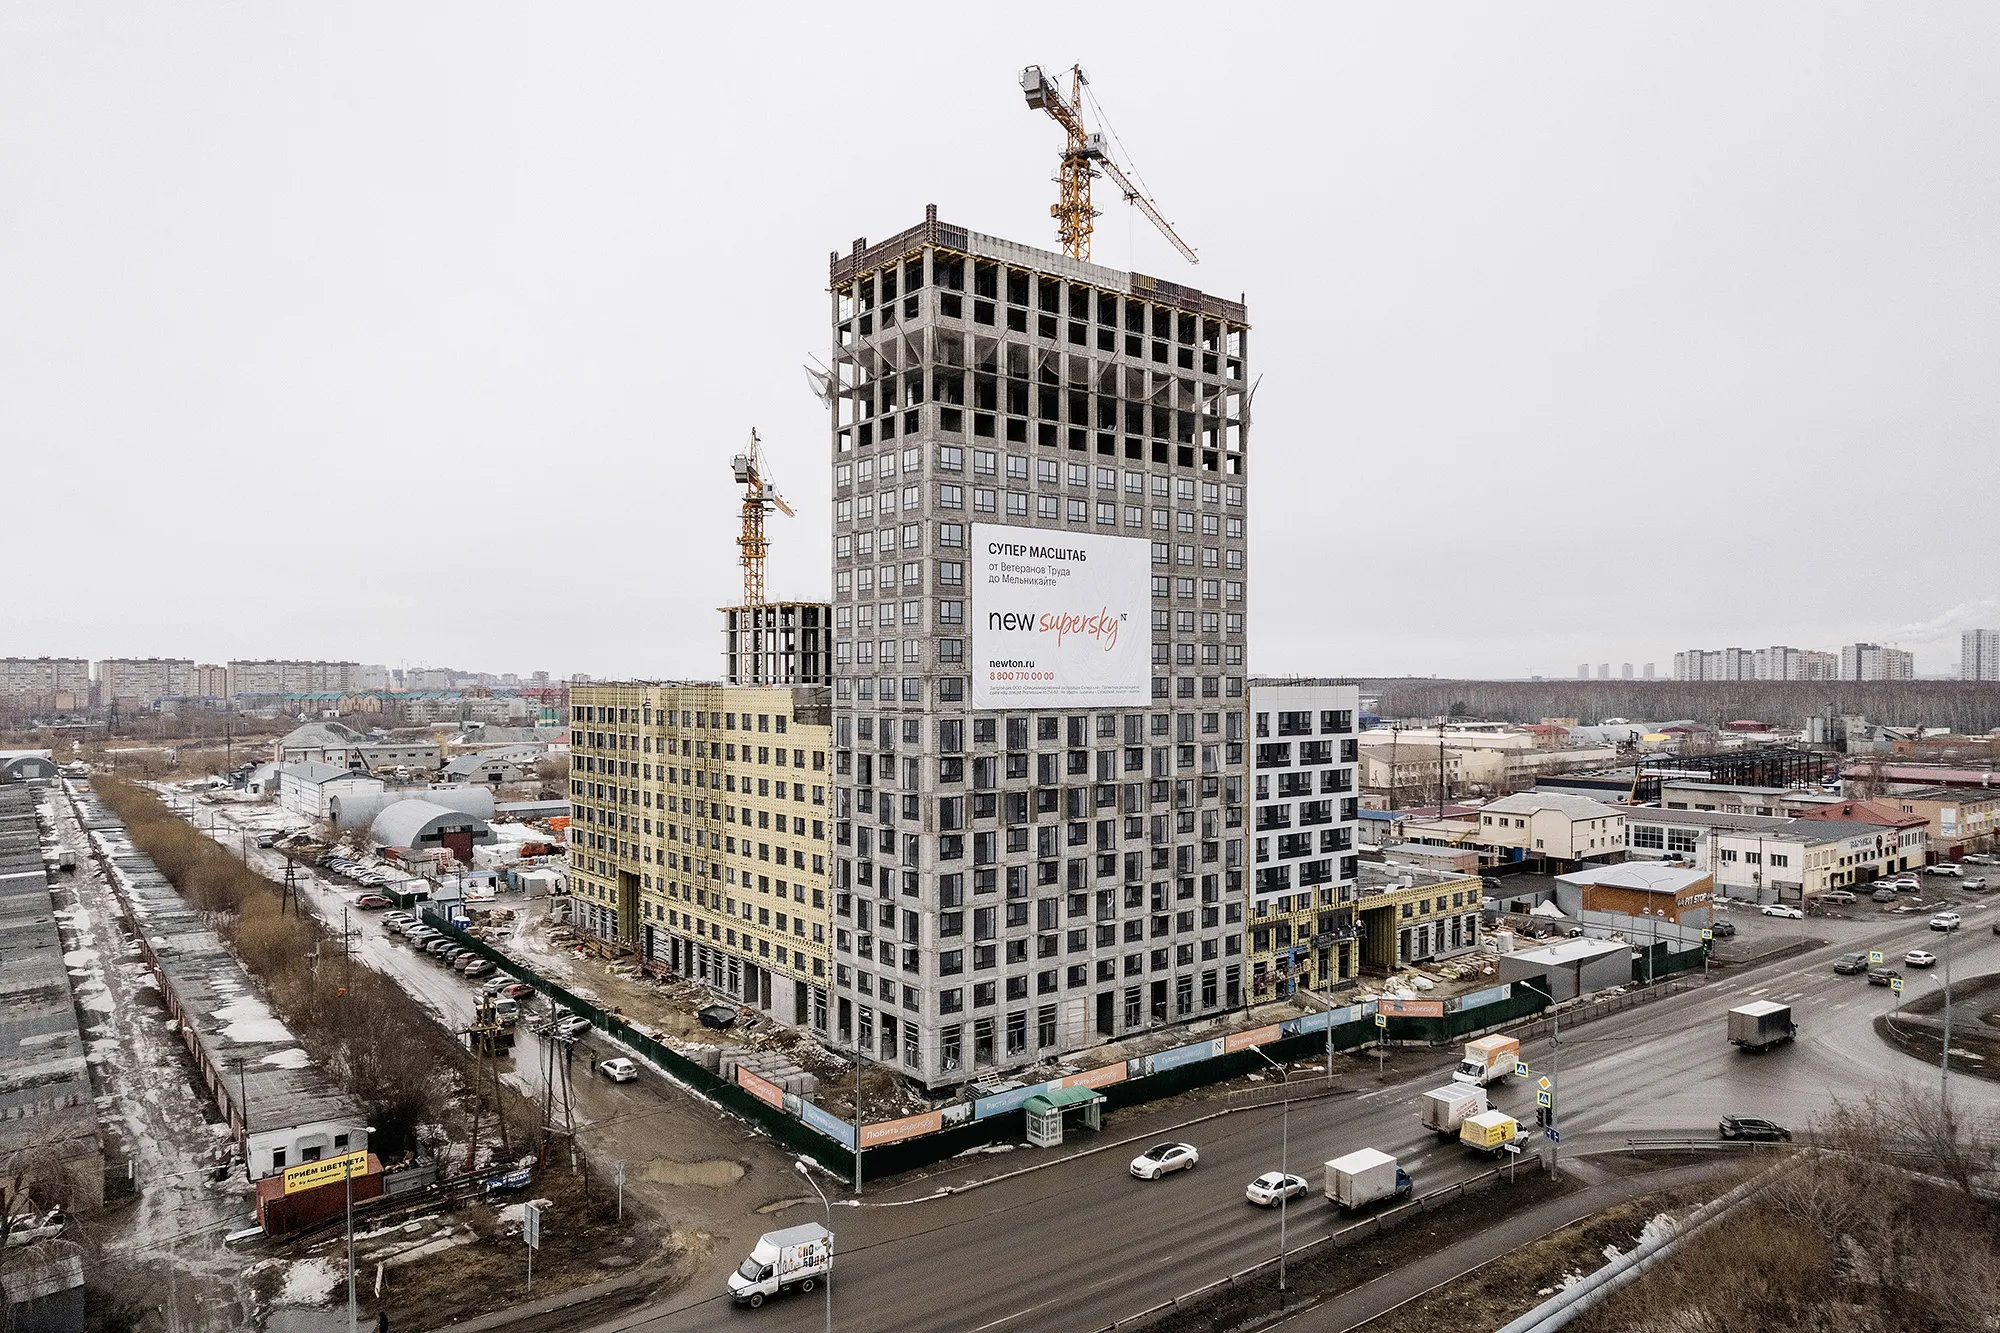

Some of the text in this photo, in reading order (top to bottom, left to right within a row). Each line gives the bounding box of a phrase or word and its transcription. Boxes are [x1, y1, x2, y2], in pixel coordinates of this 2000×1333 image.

[988, 542, 1087, 562] СУПЕР МАСШТАБ
[988, 562, 1071, 577] от Ветеранов Труда
[988, 574, 1057, 587] до Мельникайте
[989, 611, 1035, 632] new
[1039, 606, 1119, 652] supersky
[989, 659, 1035, 669] newton.ru
[989, 671, 1055, 681] 8 800 770 00 00
[1685, 893, 1707, 905] PIT STOP
[986, 1100, 1007, 1110] Расти
[866, 1118, 934, 1139] Любить supersky
[320, 1157, 365, 1173] ЦВЕТМЕТА
